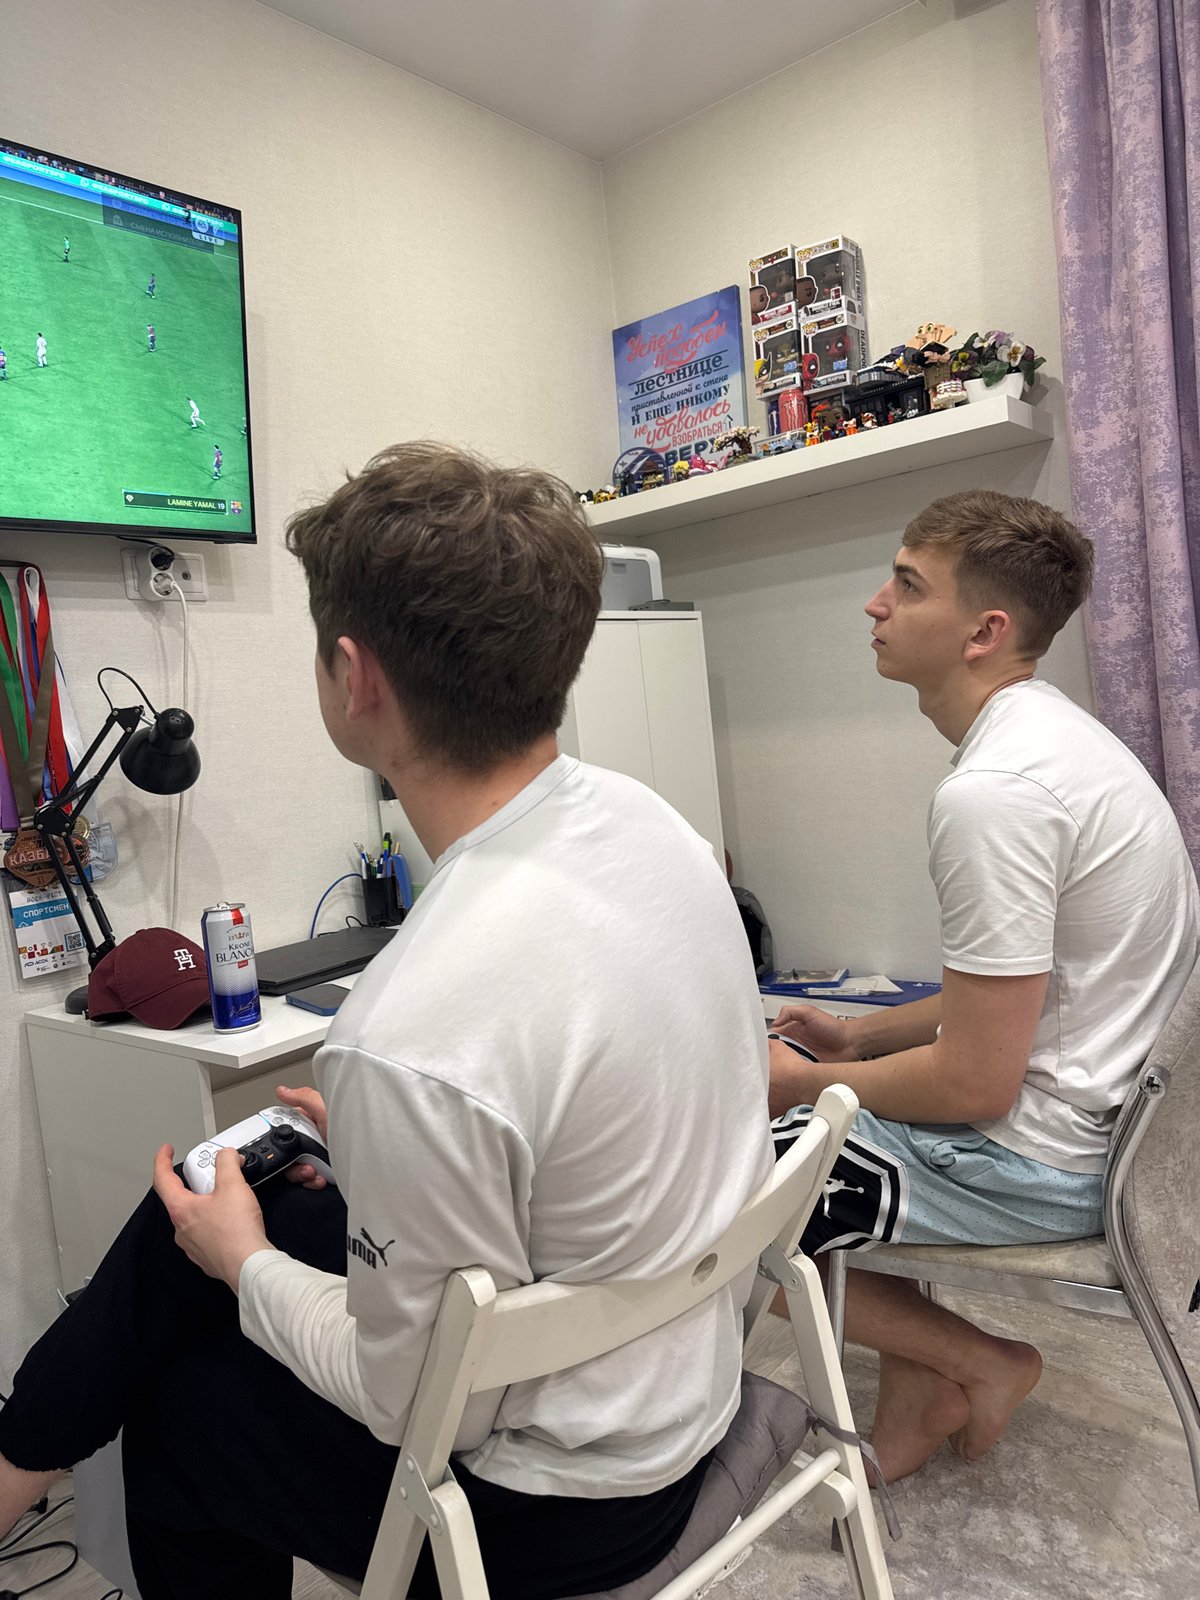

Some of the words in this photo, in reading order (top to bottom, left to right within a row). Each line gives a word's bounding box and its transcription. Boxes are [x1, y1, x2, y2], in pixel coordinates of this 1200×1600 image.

[676, 384, 730, 411] НИКОМУ
[634, 424, 648, 439] не
[646, 399, 731, 453] удавалось
[671, 421, 723, 447] ВЗОБРАТЬСЯ
[167, 498, 192, 507] LAMINE
[194, 500, 216, 509] YAMAL
[23, 902, 70, 918] СПОРТСМЕН
